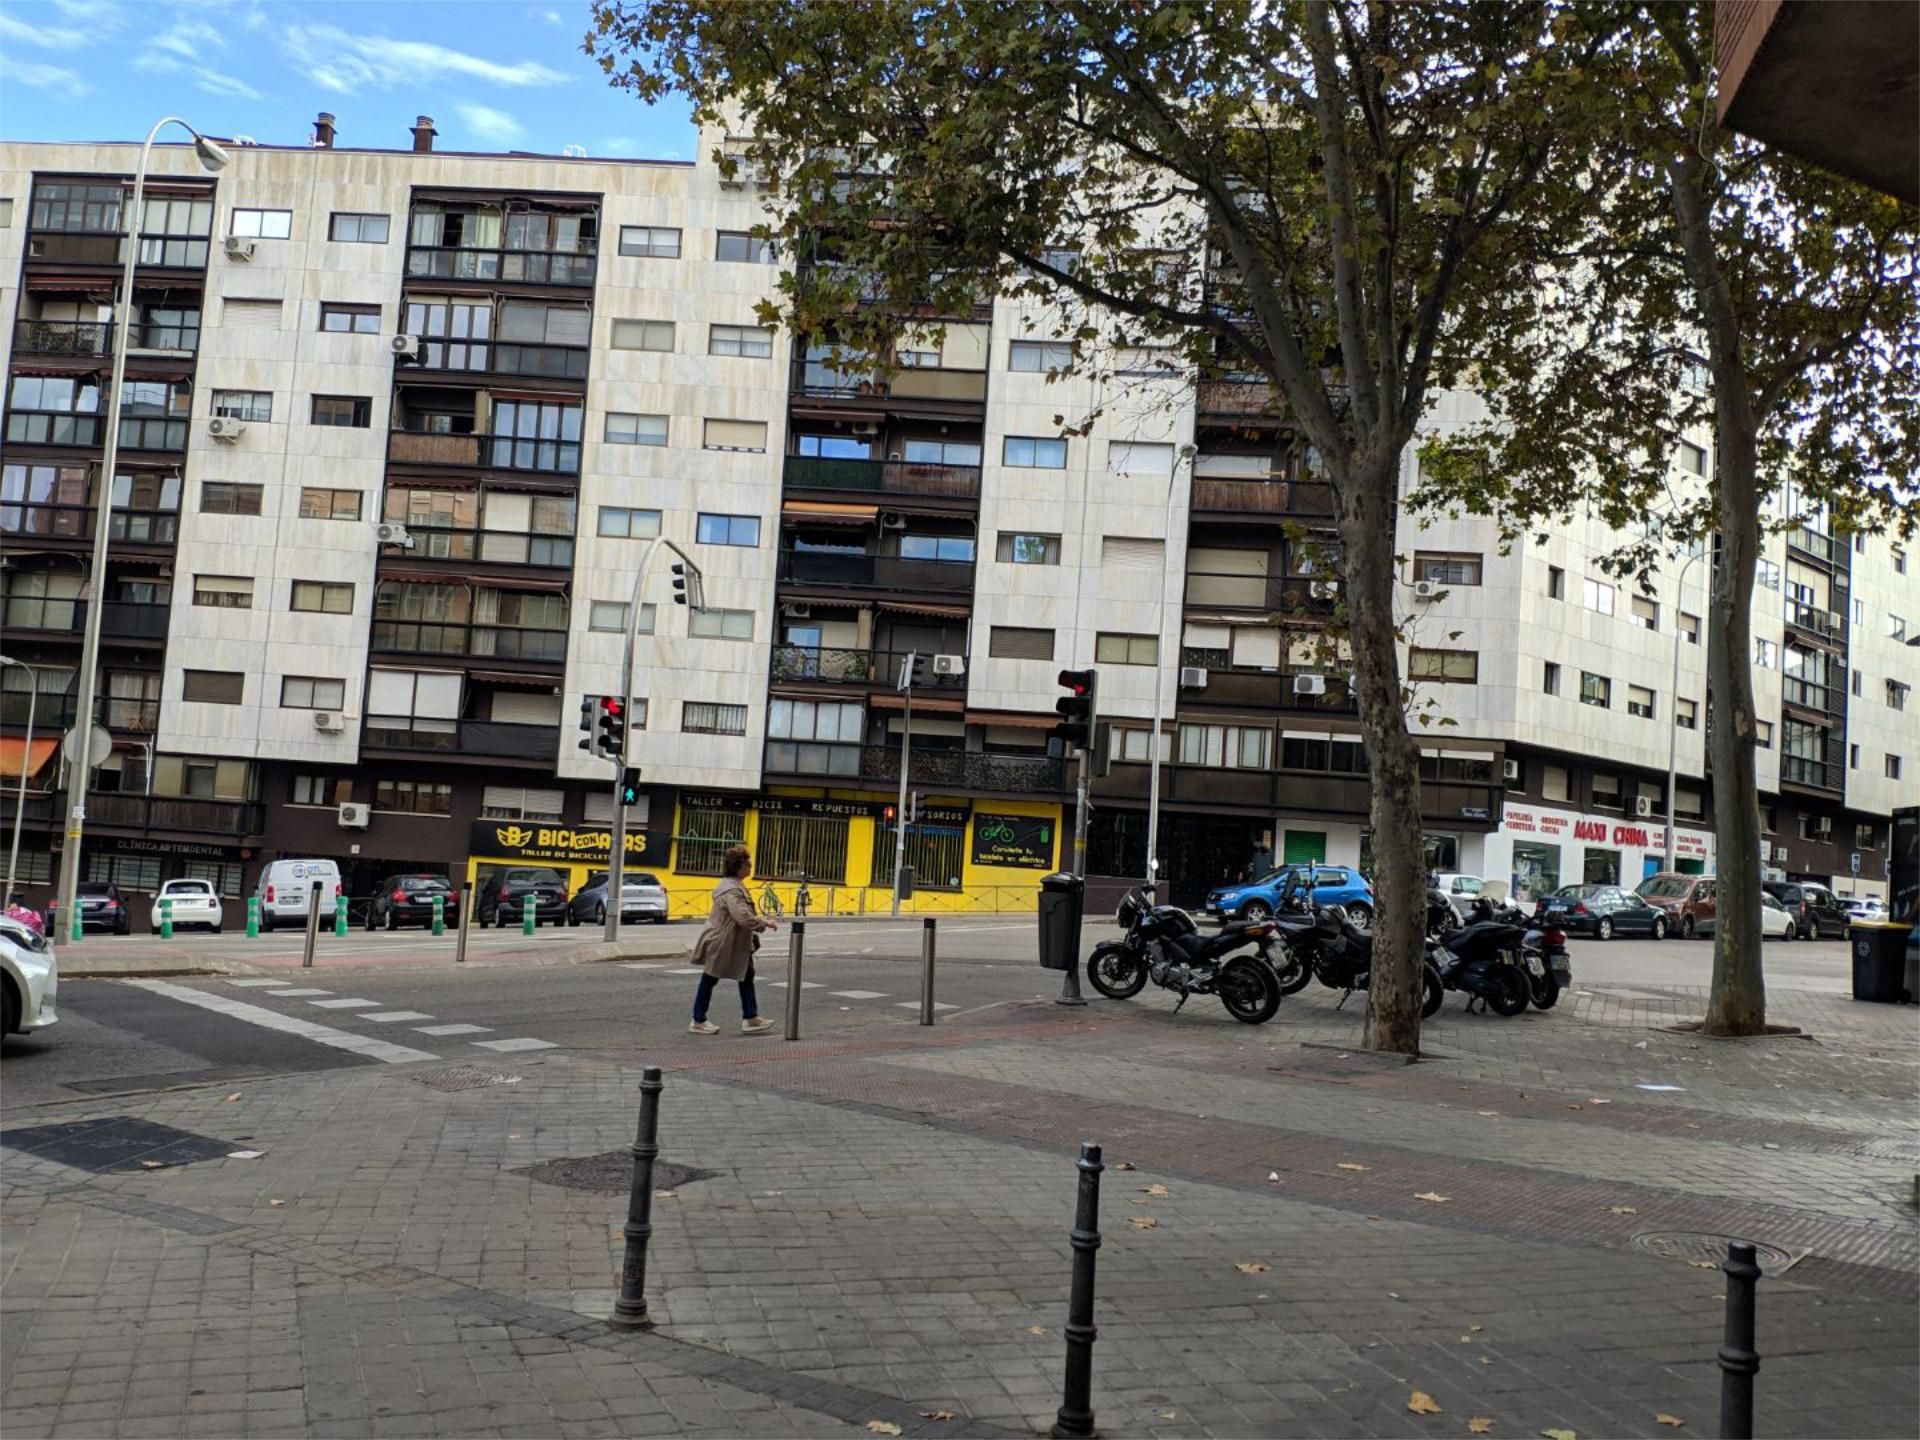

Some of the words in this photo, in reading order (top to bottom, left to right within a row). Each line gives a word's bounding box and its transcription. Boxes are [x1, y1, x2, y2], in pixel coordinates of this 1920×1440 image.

[686, 796, 723, 807] TALLER
[752, 801, 783, 810] BICIS
[811, 803, 869, 816] REPUESTOS
[576, 834, 598, 848] CON
[1574, 820, 1607, 842] MAXI
[1613, 826, 1649, 848] CHINA
